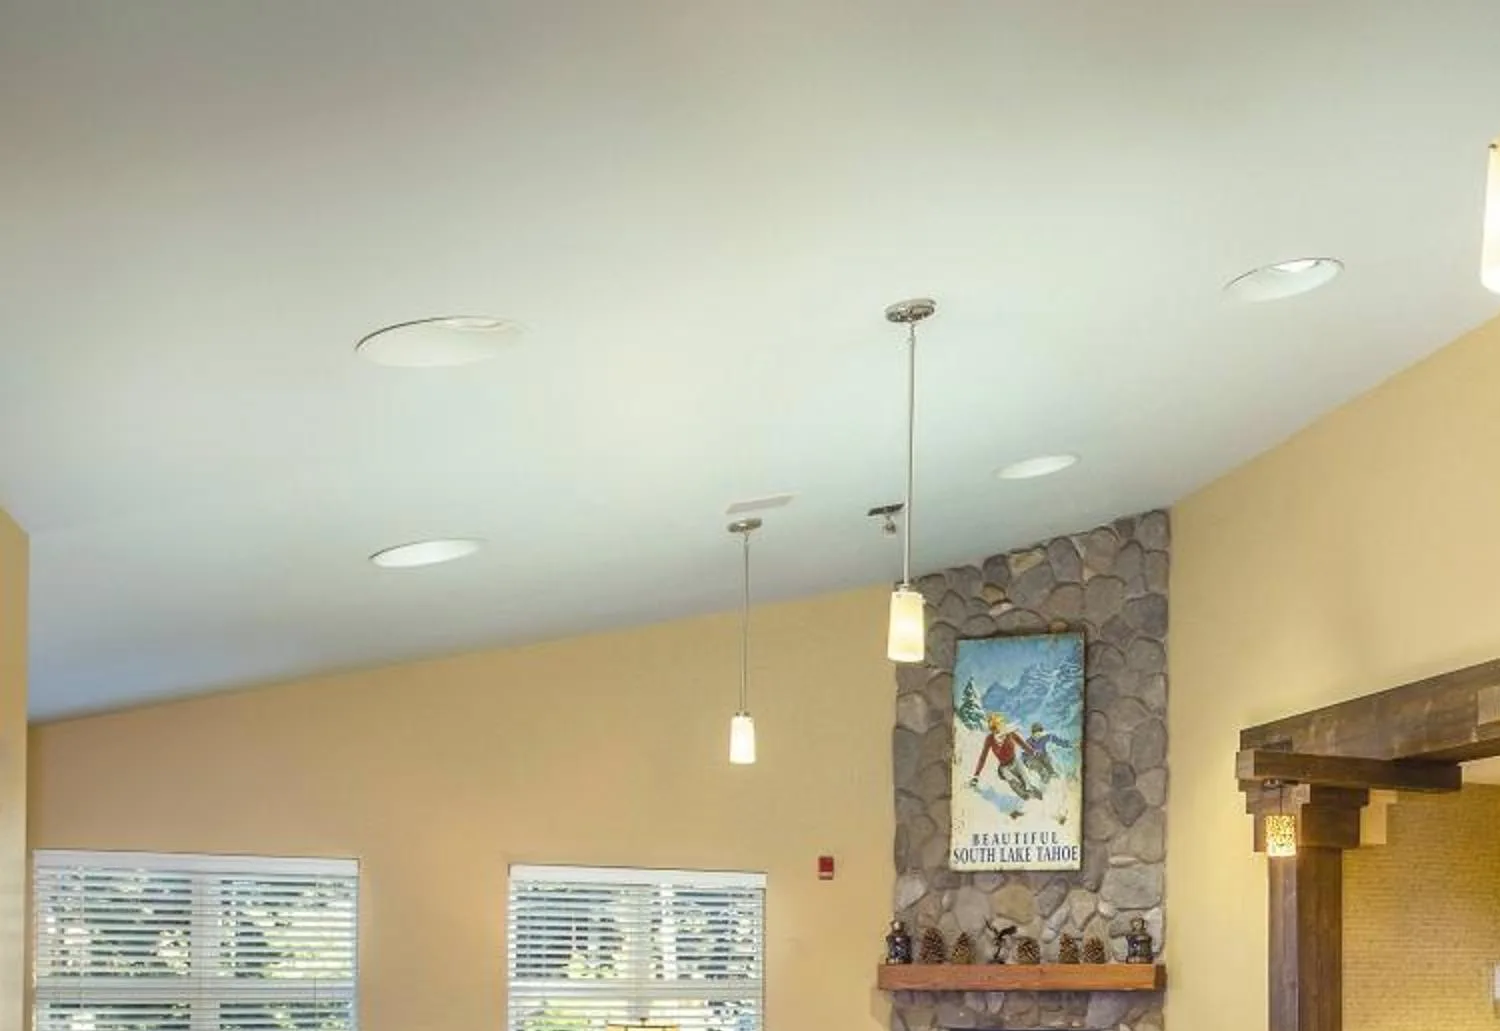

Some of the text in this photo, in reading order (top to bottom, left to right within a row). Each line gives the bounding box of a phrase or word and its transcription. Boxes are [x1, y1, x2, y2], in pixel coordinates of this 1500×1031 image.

[972, 831, 1059, 846] BEAUTIFUL
[953, 845, 1079, 864] SOUTH LAKE TAHOE
